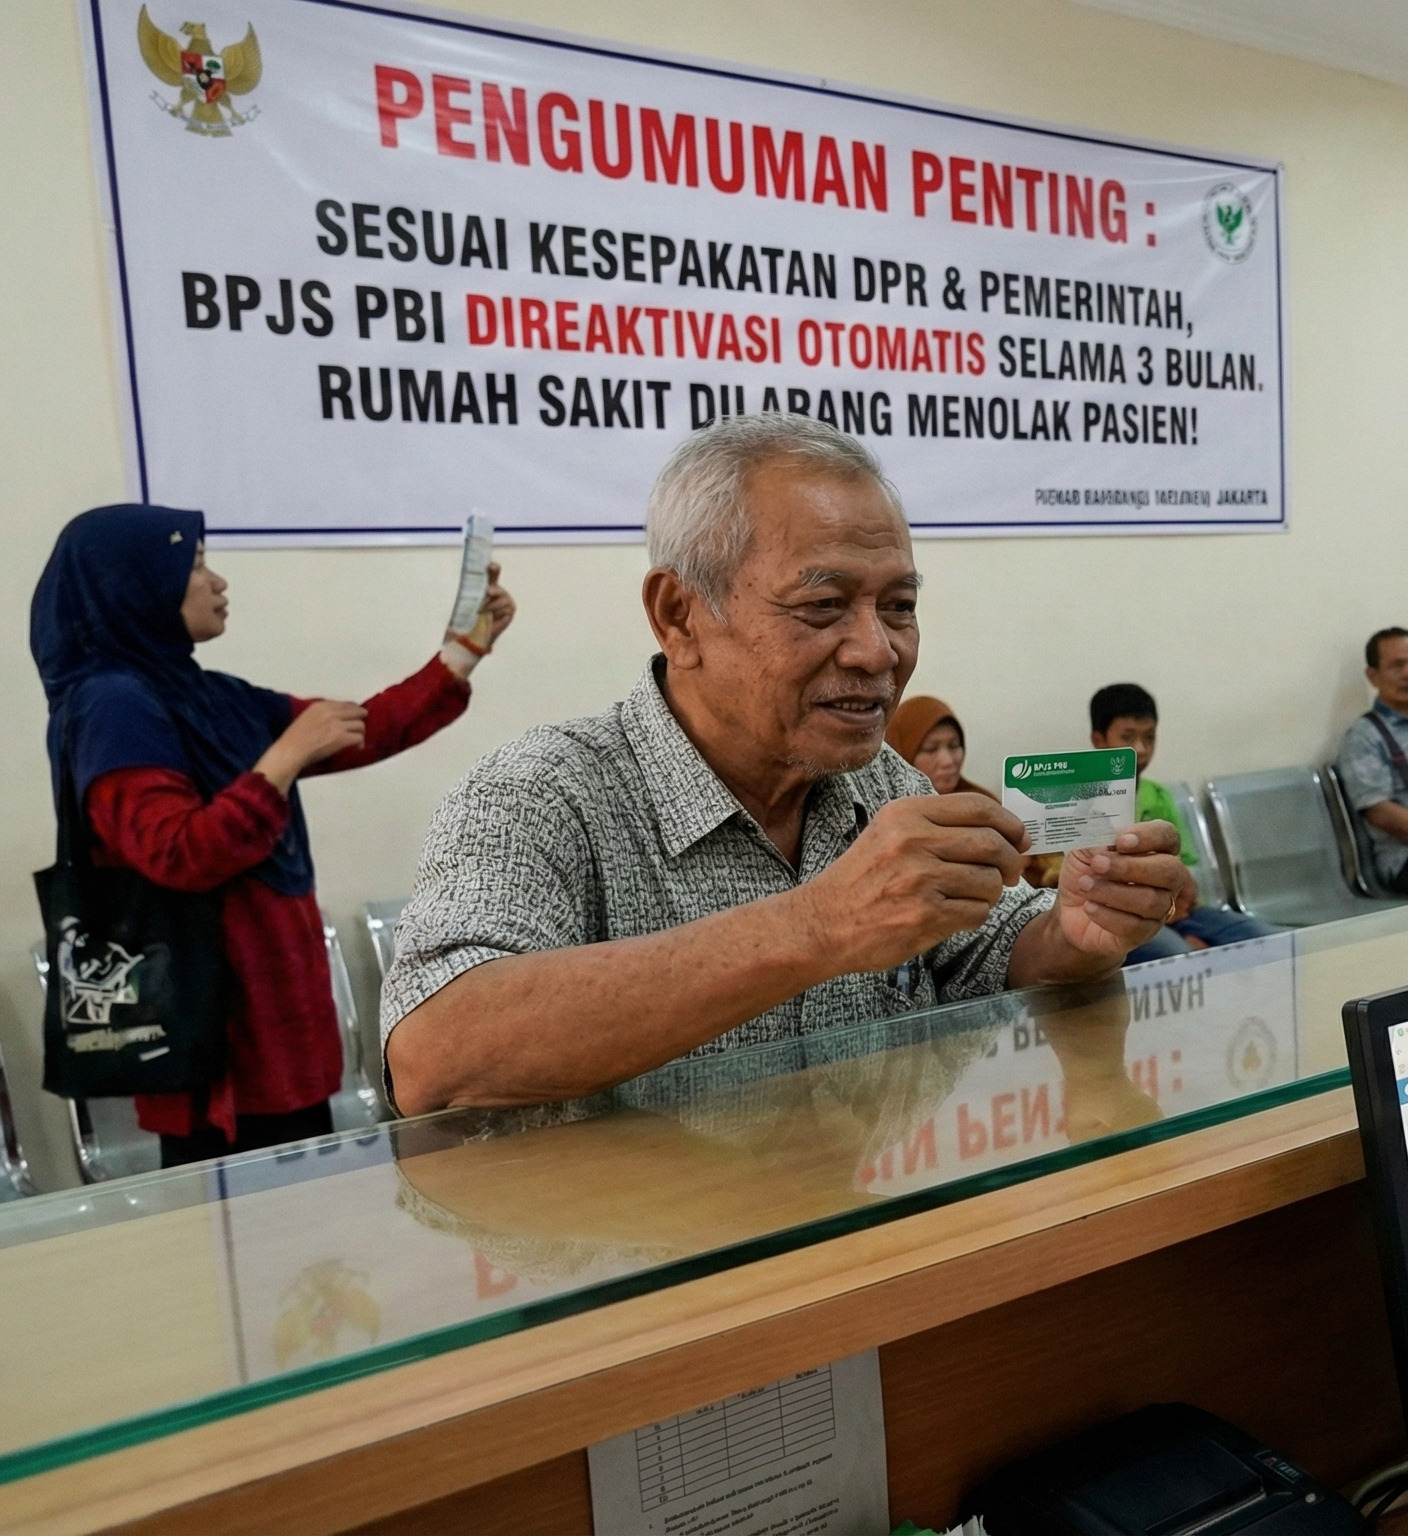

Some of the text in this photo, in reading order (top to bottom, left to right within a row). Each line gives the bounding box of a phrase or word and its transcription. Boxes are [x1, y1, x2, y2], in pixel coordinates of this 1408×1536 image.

[373, 63, 889, 213] PENGUMUMAN
[911, 149, 1127, 244] PENTING
[181, 271, 1263, 391] BPJS PBI DIREAKTIVASI OTOMATIS SELAMA 3 BULAN.
[315, 199, 1194, 337] SESUAI KESEPAKATAN DPR & PEMERINTAH,
[318, 364, 518, 425] RUMAH
[538, 374, 672, 429] SAKIT
[907, 393, 1072, 442] MENOLAK
[1083, 401, 1198, 445] PASIEN!
